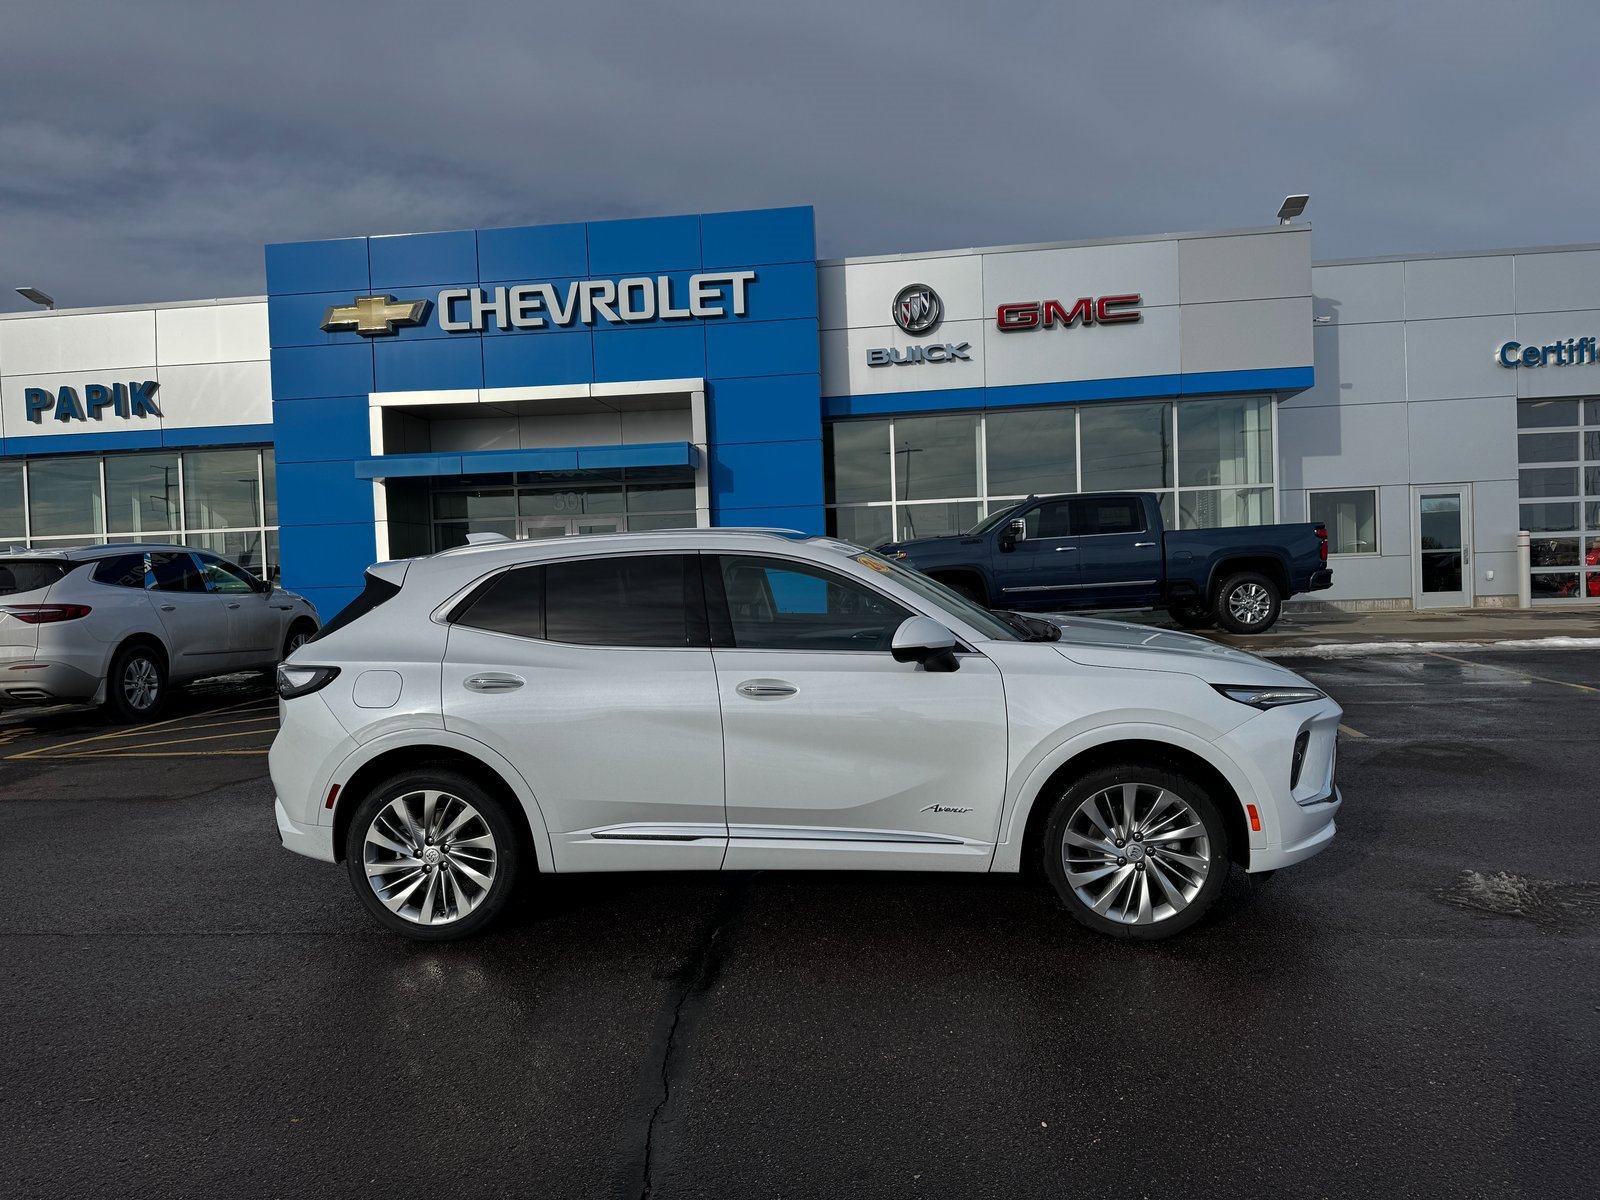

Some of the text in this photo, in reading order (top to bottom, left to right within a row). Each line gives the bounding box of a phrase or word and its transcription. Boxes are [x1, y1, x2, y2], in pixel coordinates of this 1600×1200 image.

[437, 270, 755, 331] CHEVROLET
[997, 293, 1142, 331] GMC
[866, 341, 971, 366] BUICK
[1499, 336, 1600, 368] Certifi
[24, 380, 163, 424] PAPIK
